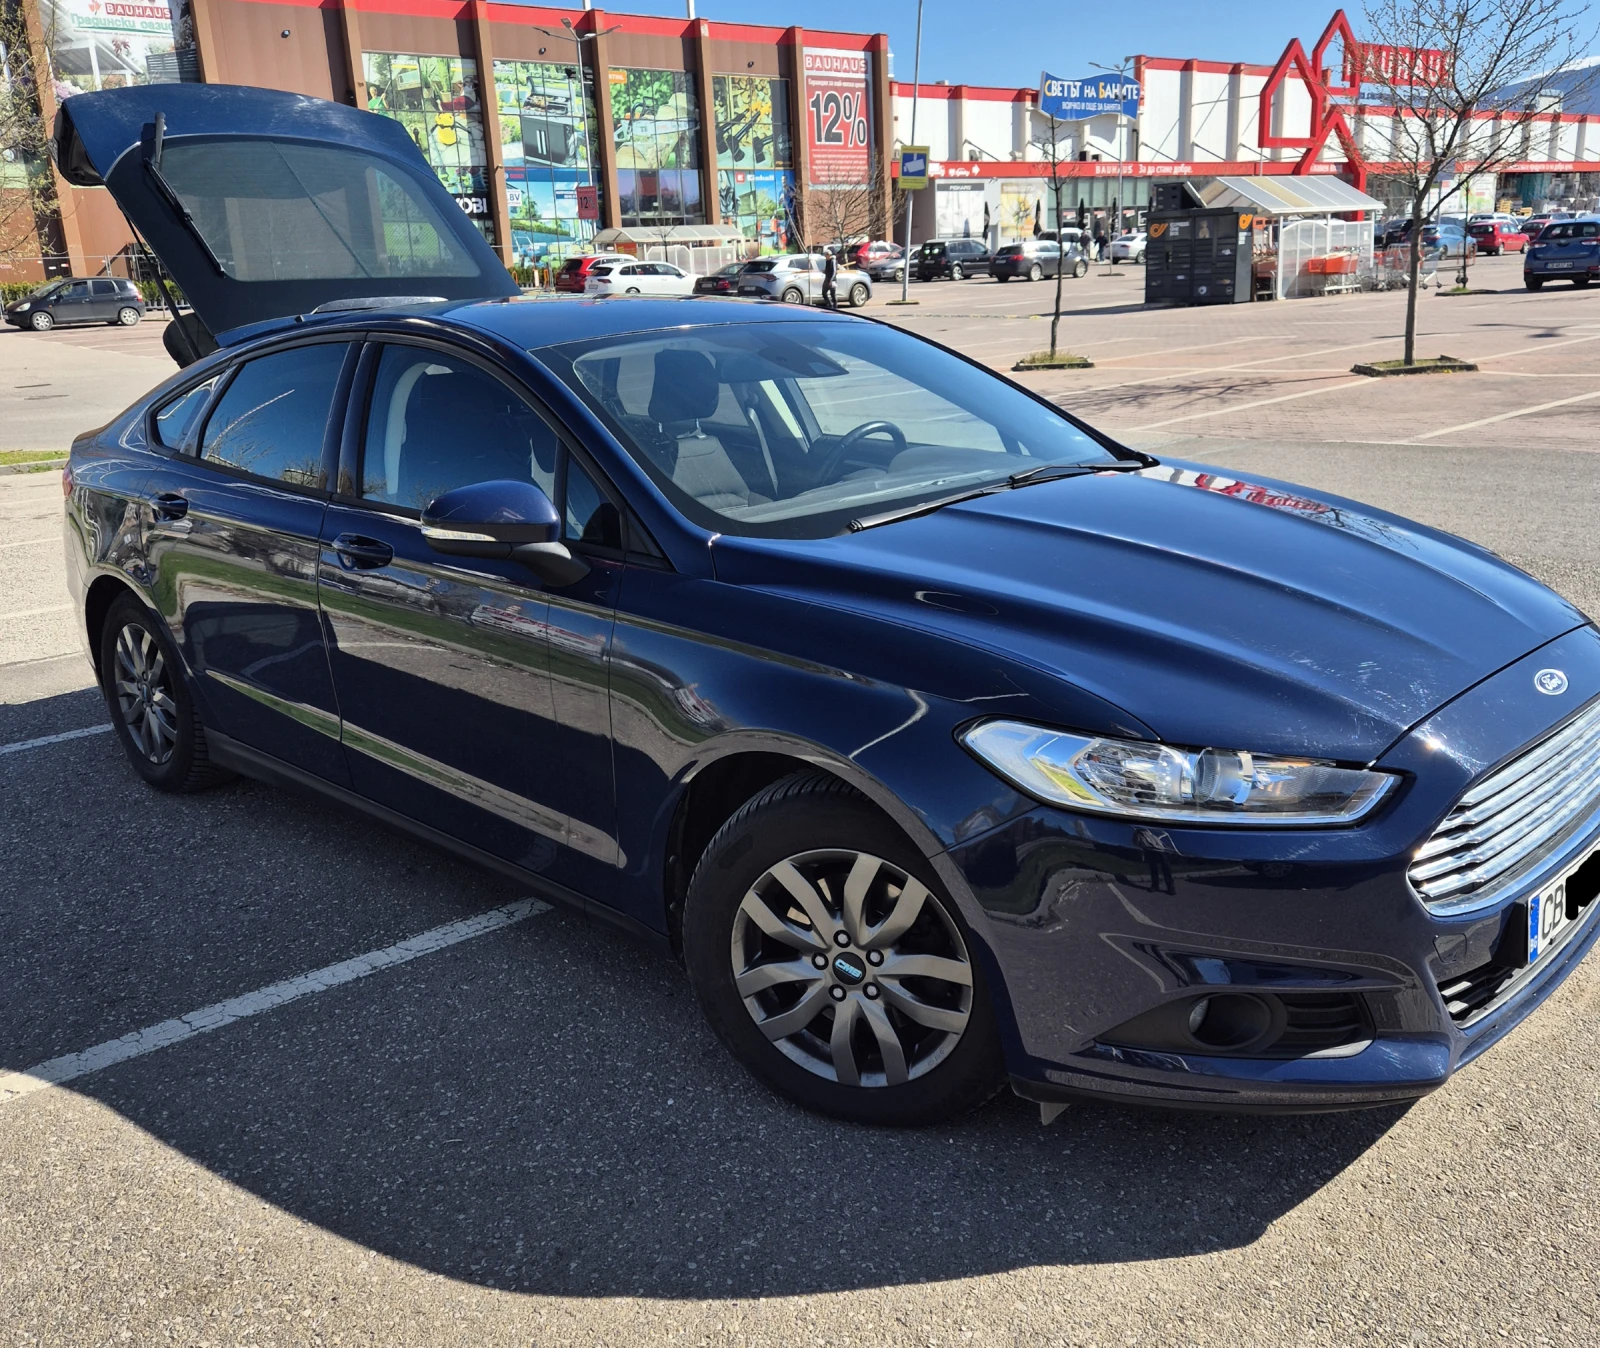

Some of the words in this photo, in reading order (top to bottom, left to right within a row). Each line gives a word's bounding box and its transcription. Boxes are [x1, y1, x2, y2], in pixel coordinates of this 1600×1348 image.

[106, 4, 171, 18] BAUHAUS
[70, 13, 136, 28] Градински
[805, 56, 866, 71] BAUHAUS
[1044, 80, 1082, 98] СВЕТЪТ
[1084, 85, 1096, 98] НА
[1062, 102, 1080, 110] ВСИЧКО
[810, 91, 867, 148] 12%
[1095, 165, 1133, 174] BAUHAUS
[1542, 883, 1564, 940] CB
[835, 959, 862, 978] CMS
